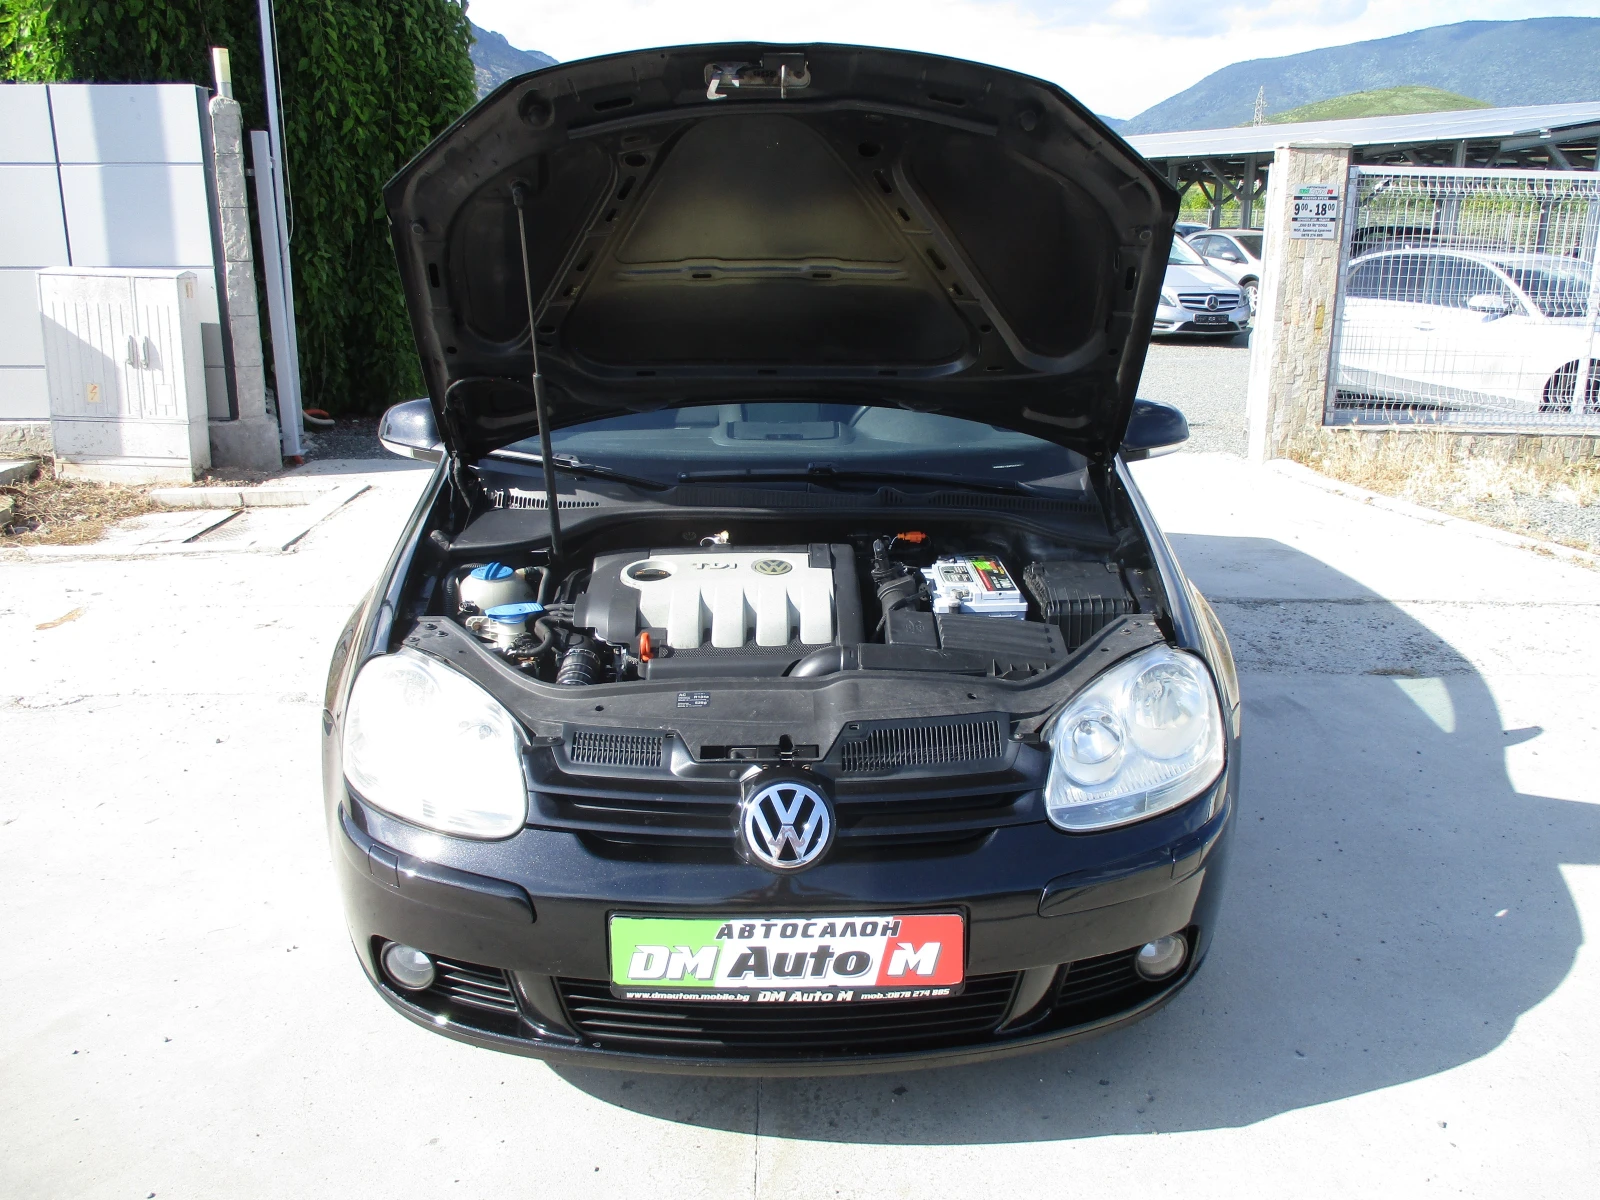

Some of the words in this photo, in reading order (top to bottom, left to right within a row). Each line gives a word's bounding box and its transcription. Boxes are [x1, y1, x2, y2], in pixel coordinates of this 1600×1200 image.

[715, 920, 902, 940] АВТОСАЛОН
[627, 945, 720, 980] DM
[727, 944, 873, 979] Auto
[887, 941, 942, 978] M
[626, 991, 750, 1002] www.dmautom.mobile.bg
[757, 990, 787, 1002] DM
[788, 990, 834, 1002] Auto
[837, 990, 855, 1002] M
[912, 988, 930, 998] 274
